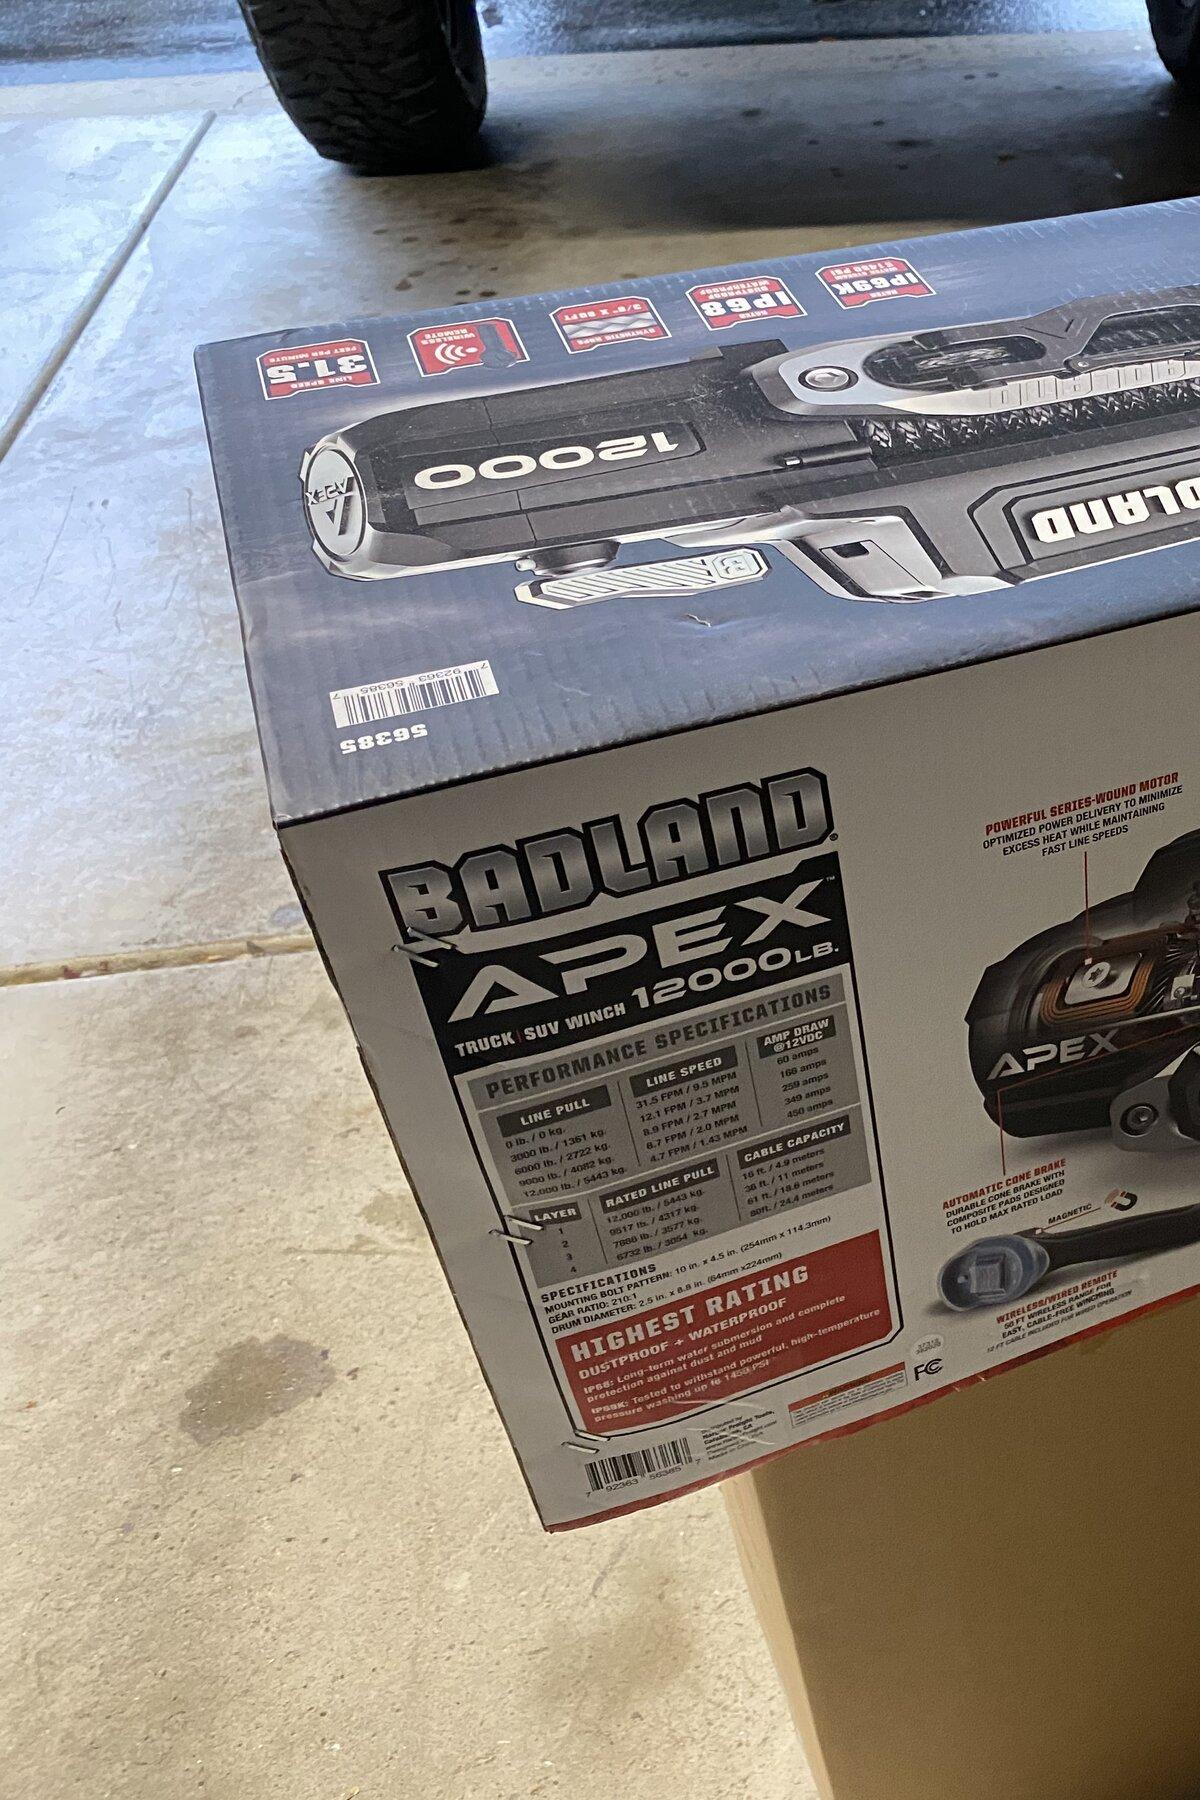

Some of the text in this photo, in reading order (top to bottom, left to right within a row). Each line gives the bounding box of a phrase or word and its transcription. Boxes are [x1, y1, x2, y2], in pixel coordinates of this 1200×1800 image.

[829, 271, 920, 295] IP69K
[697, 290, 793, 317] IP68
[265, 353, 368, 385] 31.5
[410, 429, 681, 493] 12000
[338, 722, 428, 754] 56385
[982, 784, 1182, 849] OPTIMIZED POWER DELIVERY TO MINIMIZE
[985, 771, 1179, 836] POWERFUL MOTOR
[1002, 801, 1165, 856] EXCESS HEAT WHILE MAINTAINING
[1041, 823, 1129, 857] FAST LINE SPEEDS
[377, 767, 835, 946] BADLAND
[447, 877, 832, 1024] APEX
[454, 1030, 517, 1059] TRUCK
[522, 1018, 561, 1041] SUV
[564, 1000, 627, 1030] WINCH
[485, 982, 831, 1101] PERFORMANCE SPECIFICATIONS
[762, 1017, 830, 1046] AMP DRAW
[772, 1029, 823, 1054] @12VDC
[791, 1045, 819, 1061] amps
[799, 1057, 827, 1073] amps
[985, 1027, 1120, 1081] APEX
[645, 1056, 723, 1088] LINE SPEED
[801, 1071, 829, 1087] amps
[659, 1087, 684, 1102] FPM
[803, 1084, 831, 1100] amps
[806, 1097, 834, 1113] amps
[519, 1097, 590, 1126] LINE PULL
[663, 1101, 687, 1115] FPM
[710, 1099, 737, 1115] MPM
[713, 1113, 740, 1128] MPM
[722, 1124, 748, 1140] MPM
[743, 1122, 845, 1163] CABLE CAPACITY
[605, 1165, 715, 1208] RATED LINE PULL
[942, 1157, 1066, 1211] AUTOMATIC CONE BRAKE
[987, 1169, 1065, 1204] CONE WITH
[533, 1206, 577, 1222] LAYER
[946, 1203, 996, 1227] COMPOSITE
[989, 1197, 1038, 1221] MAX RATED
[1047, 1202, 1092, 1224] MAGNETIC
[540, 1262, 657, 1304] SPECIFICATIONS
[1081, 1269, 1118, 1291] REMOTE
[543, 1284, 624, 1315] MOUNTING BOLT
[797, 1294, 846, 1318] complete
[1027, 1299, 1066, 1321] WIRELESS
[547, 1309, 576, 1324] GEAR
[550, 1318, 582, 1334] DRUM
[569, 1264, 809, 1364] HIGHEST RATING
[790, 1308, 880, 1347] high-temperature
[1026, 1302, 1075, 1329] CABLE-FREE
[577, 1296, 787, 1380] DUSTPROOF WATERPROOF
[586, 1377, 644, 1404] protection
[594, 1403, 643, 1423] pressure
